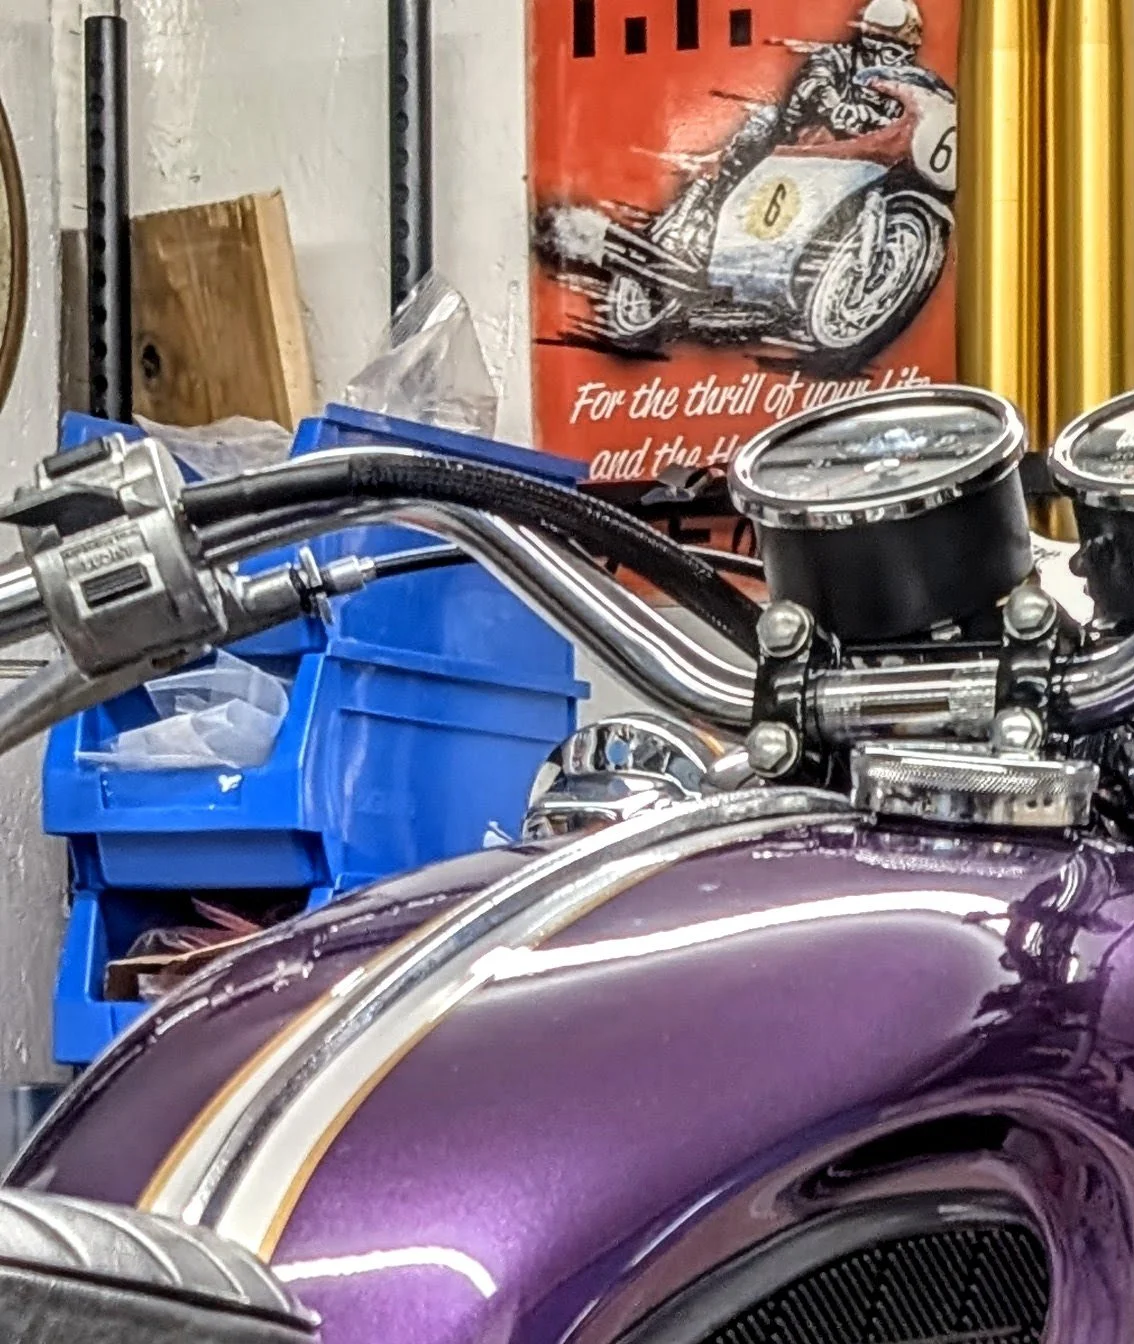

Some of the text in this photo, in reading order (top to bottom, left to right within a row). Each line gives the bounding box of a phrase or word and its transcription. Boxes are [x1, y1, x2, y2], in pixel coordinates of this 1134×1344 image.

[930, 126, 955, 174] 6
[763, 183, 787, 227] 6
[569, 382, 626, 424] For
[628, 377, 680, 420] the
[684, 373, 766, 417] thrill
[764, 370, 804, 420] of
[589, 437, 652, 480] and
[652, 435, 702, 478] the
